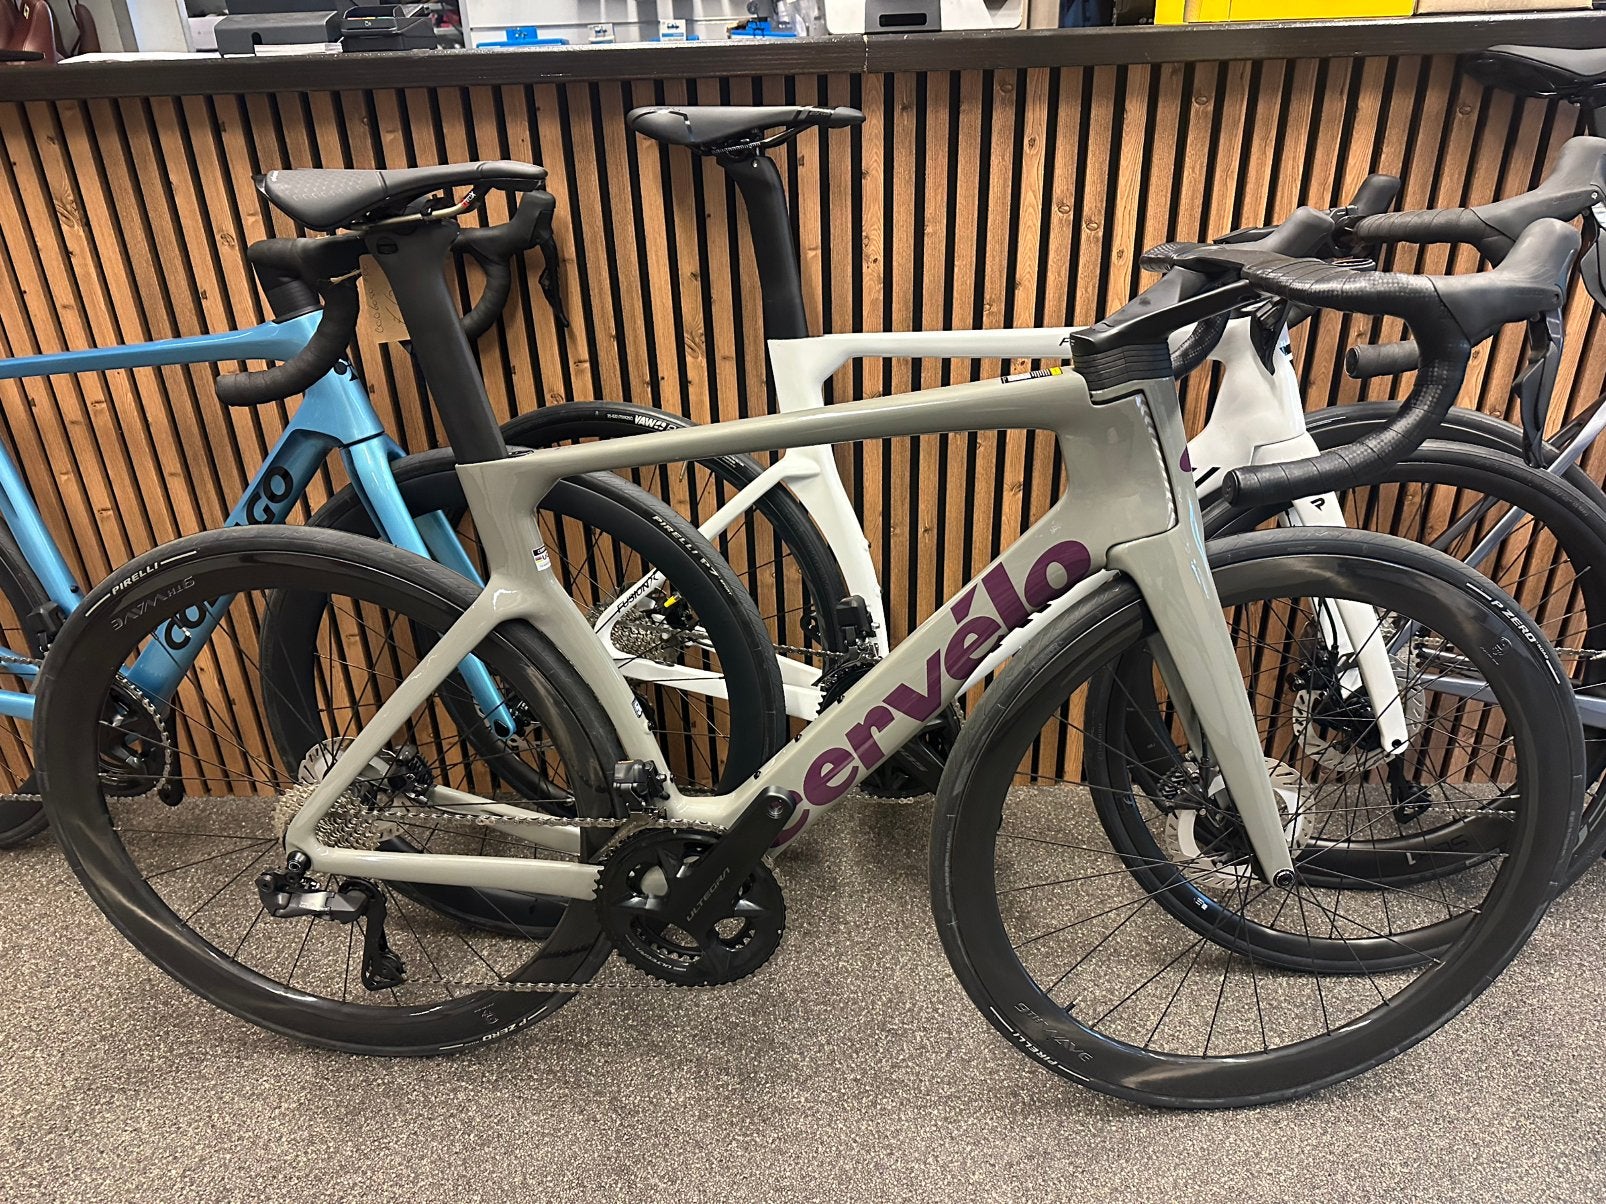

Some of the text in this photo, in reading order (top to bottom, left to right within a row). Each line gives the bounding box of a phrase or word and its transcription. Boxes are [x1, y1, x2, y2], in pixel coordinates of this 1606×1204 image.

[652, 515, 699, 555] PIRELLI
[700, 557, 719, 577] P7
[111, 561, 159, 596] PIRELLI
[1490, 600, 1504, 609] P
[1501, 608, 1537, 643] ZERO
[481, 1023, 517, 1042] ZERO
[1012, 1031, 1058, 1065] PIRELLI
